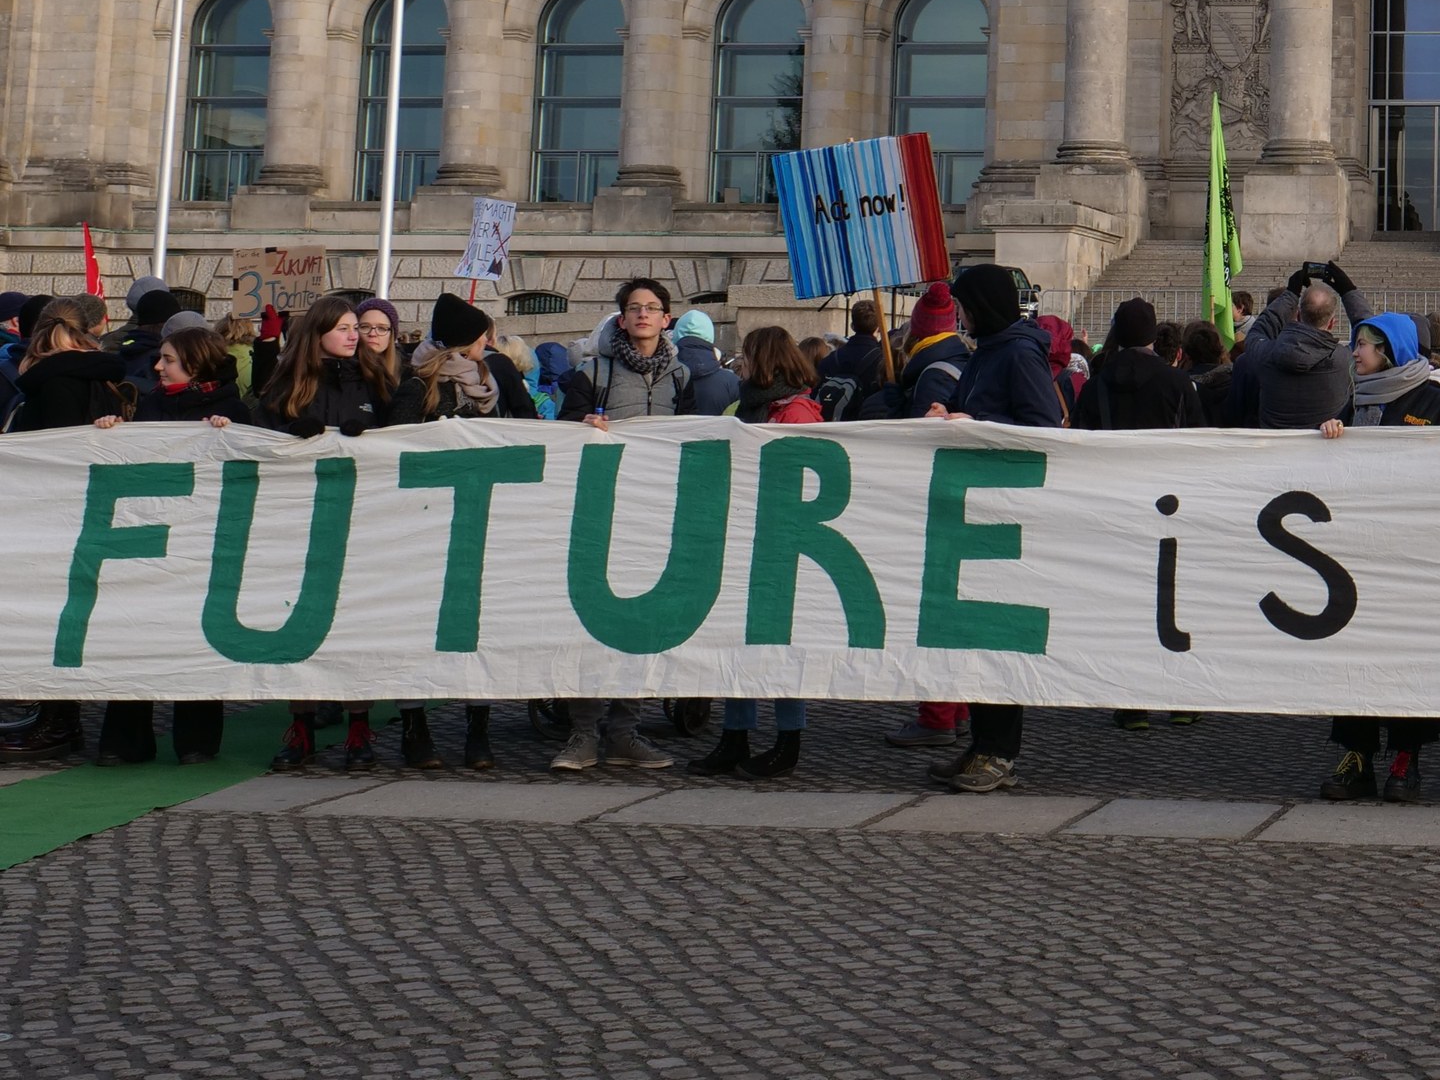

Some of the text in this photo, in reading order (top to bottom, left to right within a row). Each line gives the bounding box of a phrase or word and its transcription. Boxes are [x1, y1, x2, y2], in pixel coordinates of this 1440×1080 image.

[815, 190, 850, 224] Act
[238, 271, 262, 317] 3
[54, 436, 1049, 667] FUTURE
[1155, 490, 1358, 653] is
